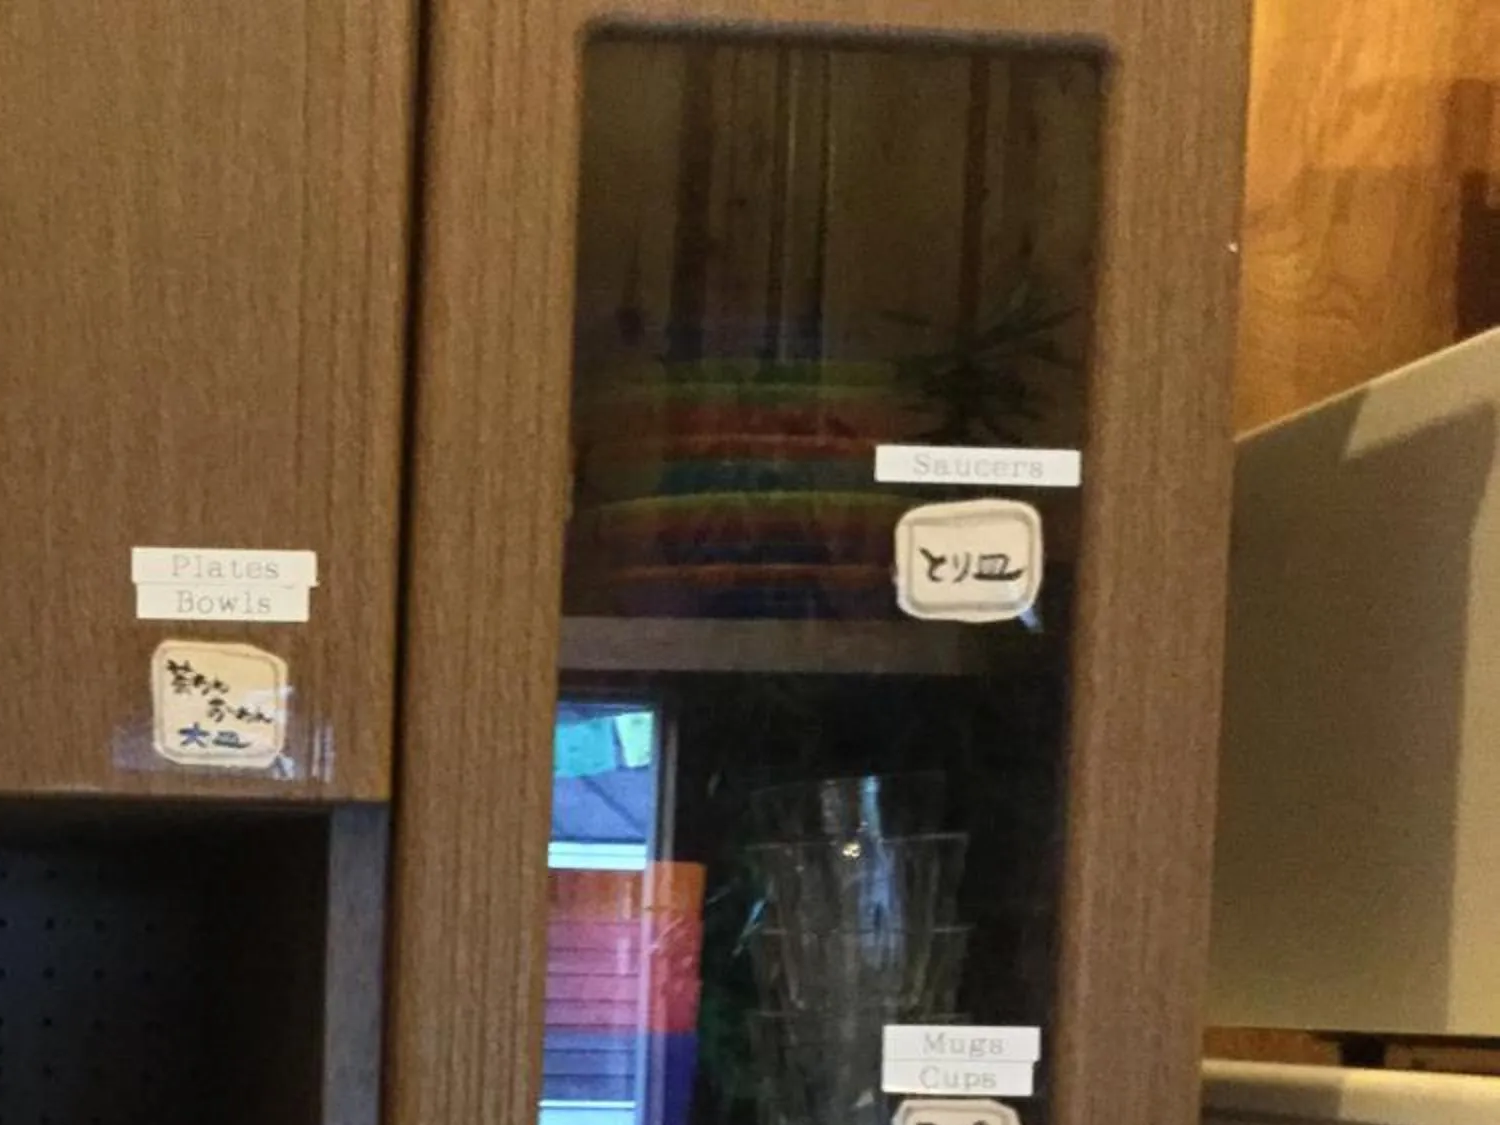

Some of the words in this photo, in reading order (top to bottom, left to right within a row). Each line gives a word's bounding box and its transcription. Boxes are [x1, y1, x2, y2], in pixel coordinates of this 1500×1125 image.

[912, 453, 1045, 480] Saucers
[170, 553, 280, 580] Plates
[176, 590, 272, 615] Bowls
[922, 1031, 1004, 1058] Mugs
[918, 1065, 997, 1090] Cups
